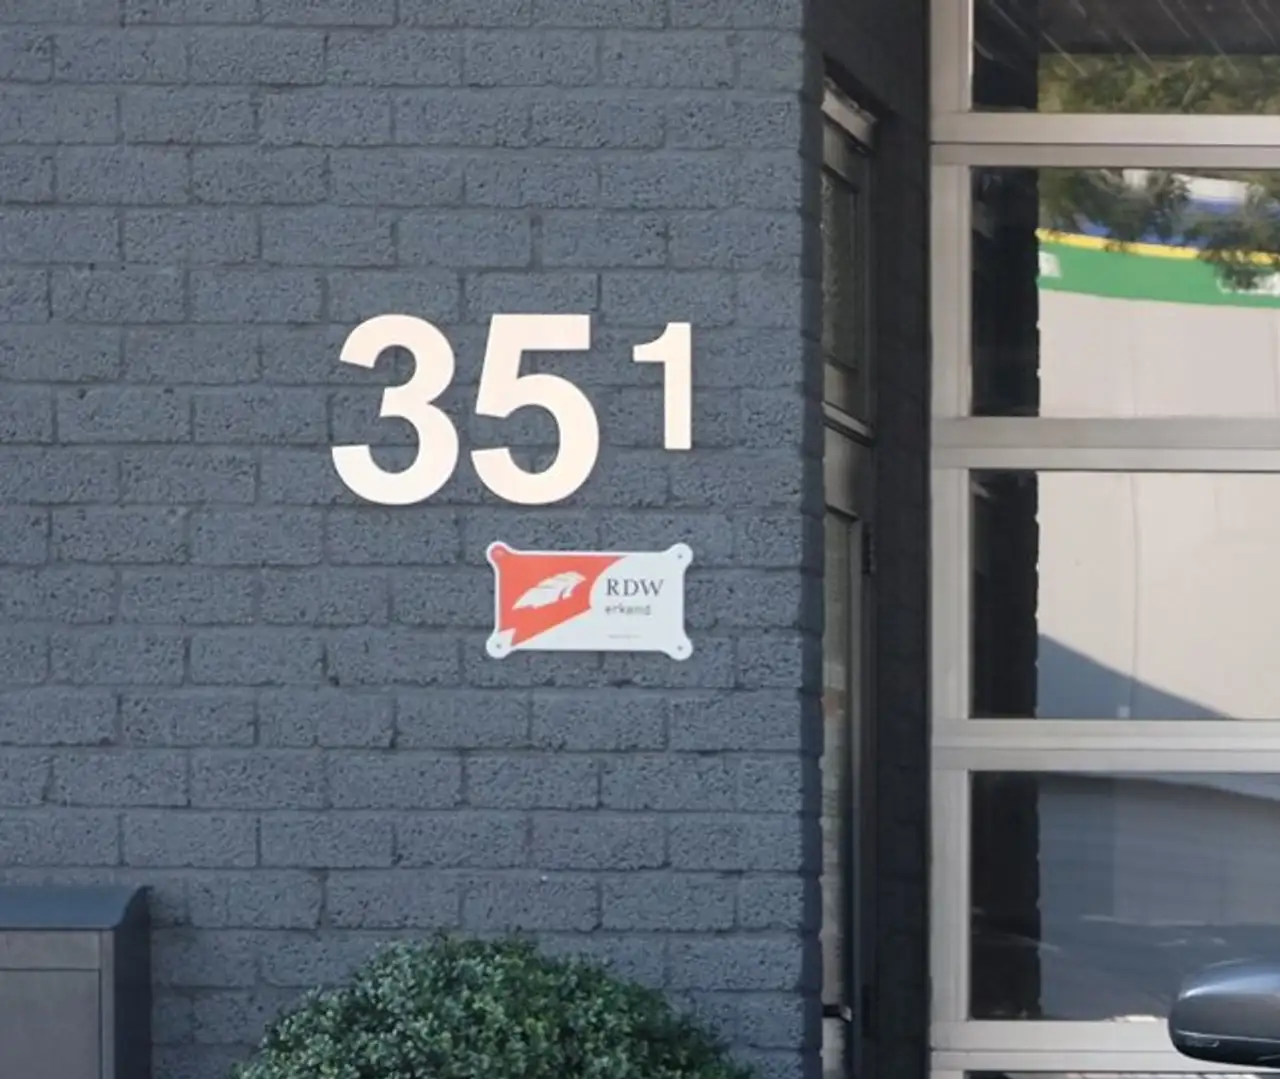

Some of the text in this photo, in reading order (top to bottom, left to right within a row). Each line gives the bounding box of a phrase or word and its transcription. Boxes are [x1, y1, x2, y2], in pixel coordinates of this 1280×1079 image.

[331, 313, 692, 506] 35 1
[606, 578, 664, 597] RDW
